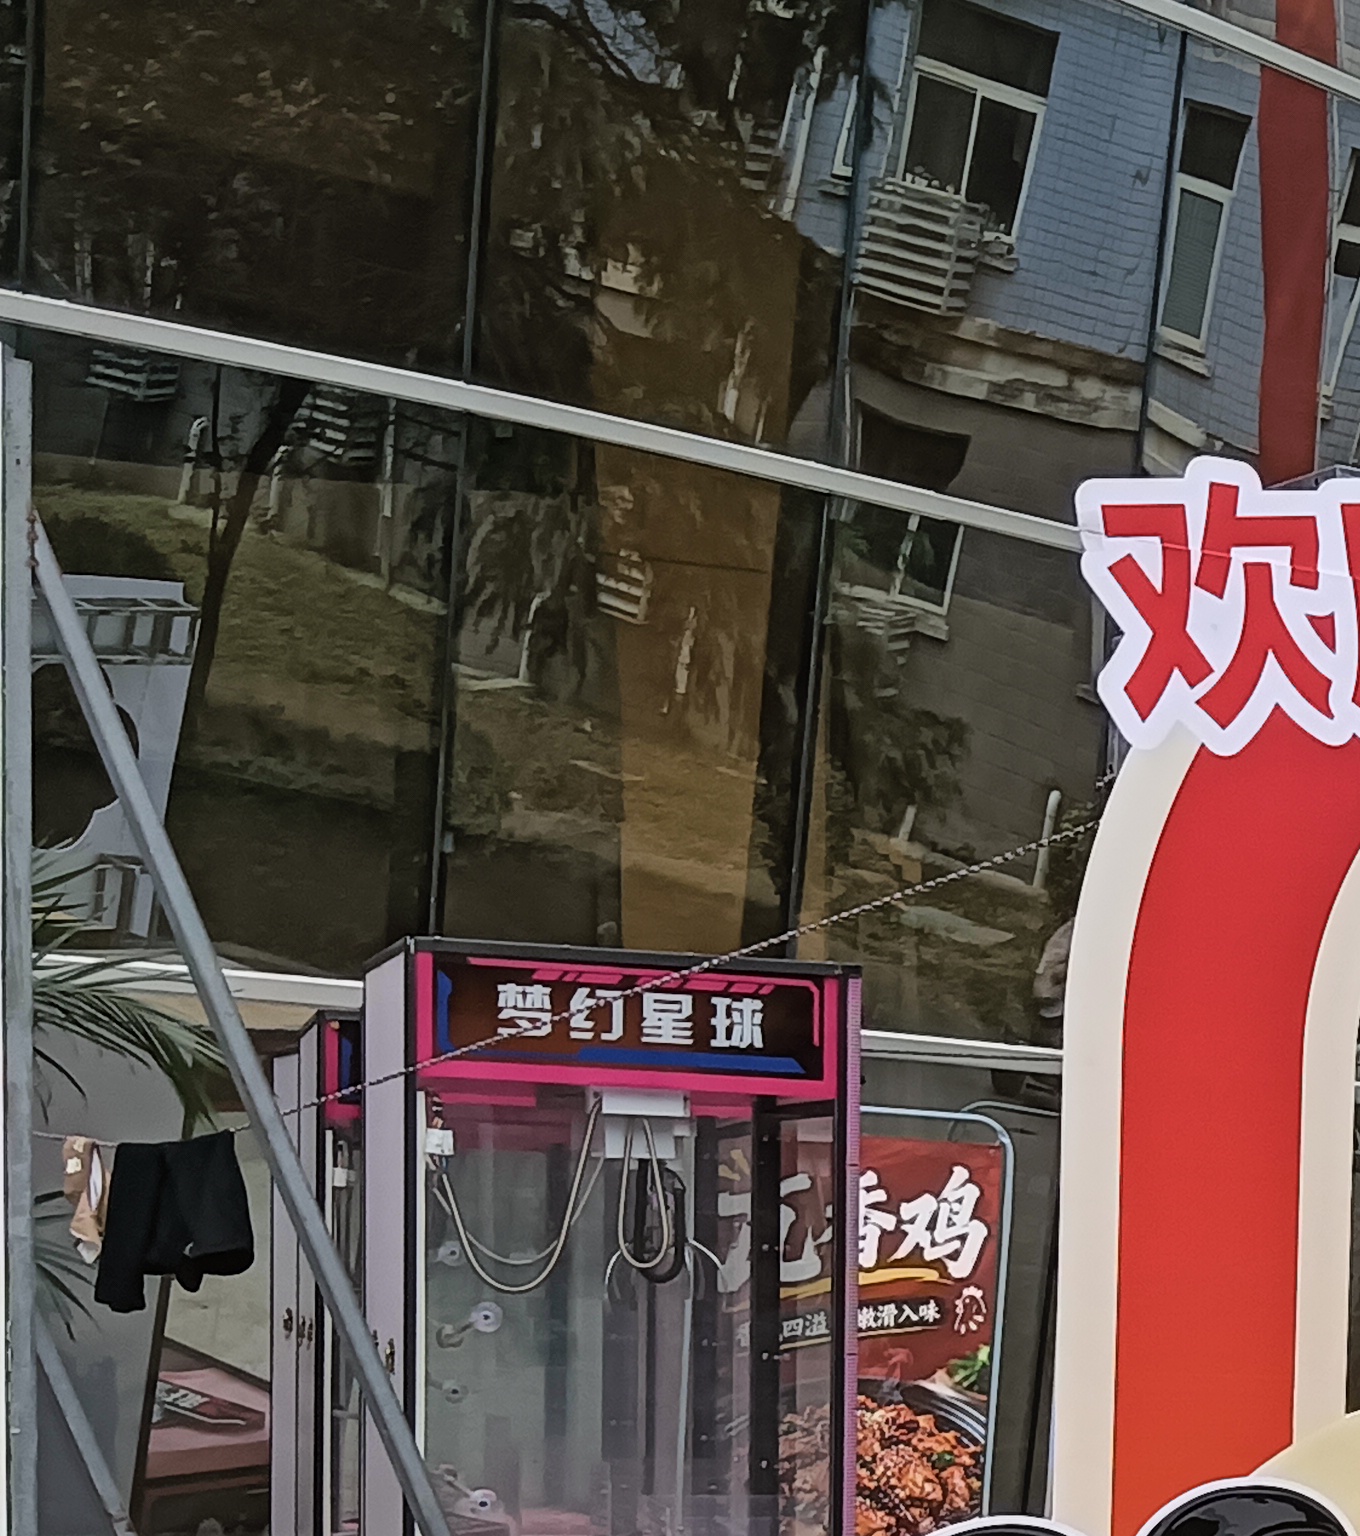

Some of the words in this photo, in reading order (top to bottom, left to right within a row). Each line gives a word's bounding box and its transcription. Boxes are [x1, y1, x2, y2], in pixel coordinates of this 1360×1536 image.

[497, 982, 765, 1048] 梦幻星球
[735, 1311, 831, 1348] 香四溢
